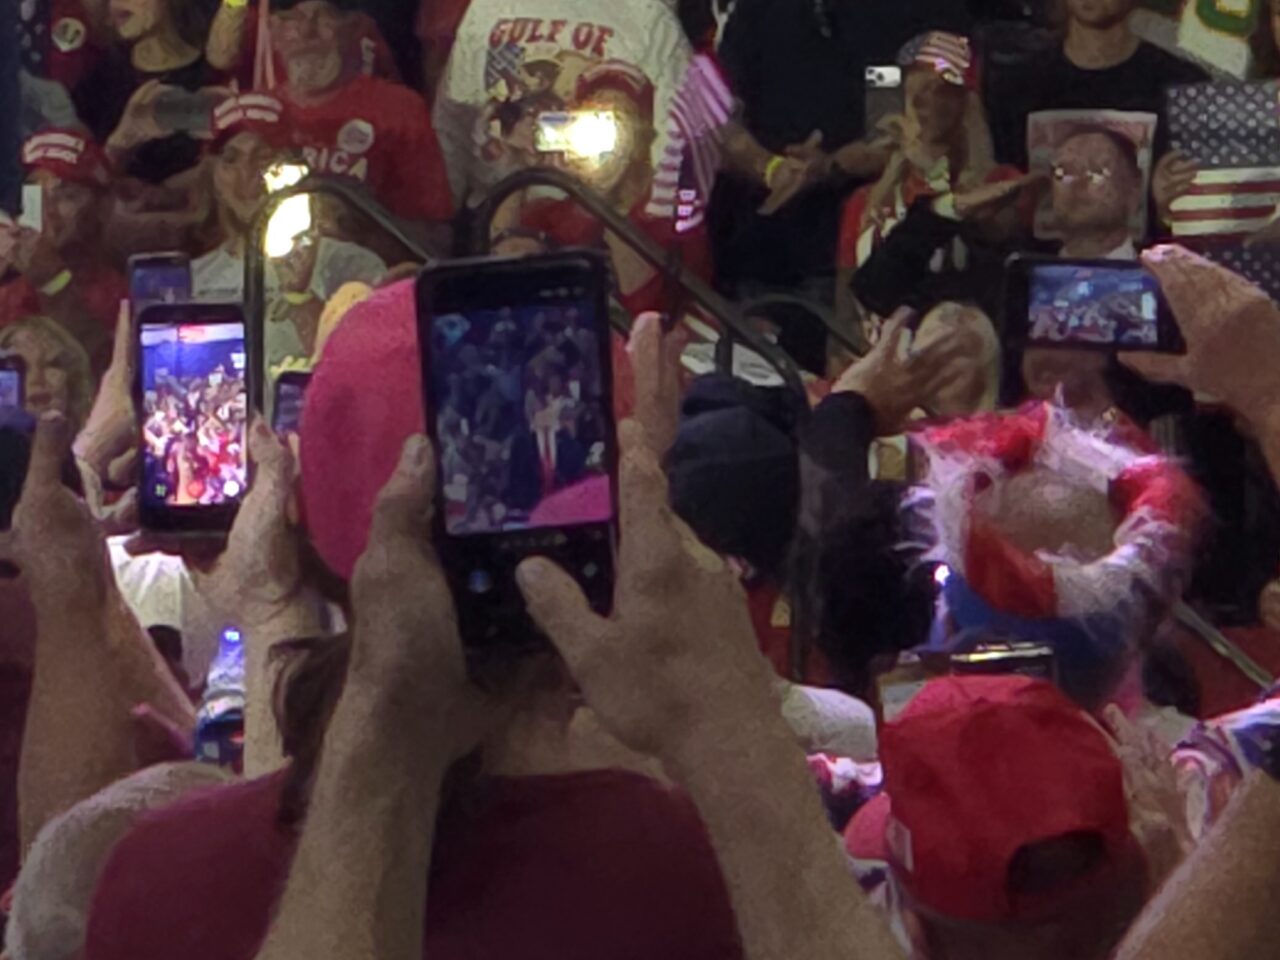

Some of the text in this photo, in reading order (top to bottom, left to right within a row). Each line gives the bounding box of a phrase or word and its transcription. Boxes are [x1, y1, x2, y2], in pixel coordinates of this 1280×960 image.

[489, 17, 614, 57] GULF OF
[302, 146, 368, 181] RICA
